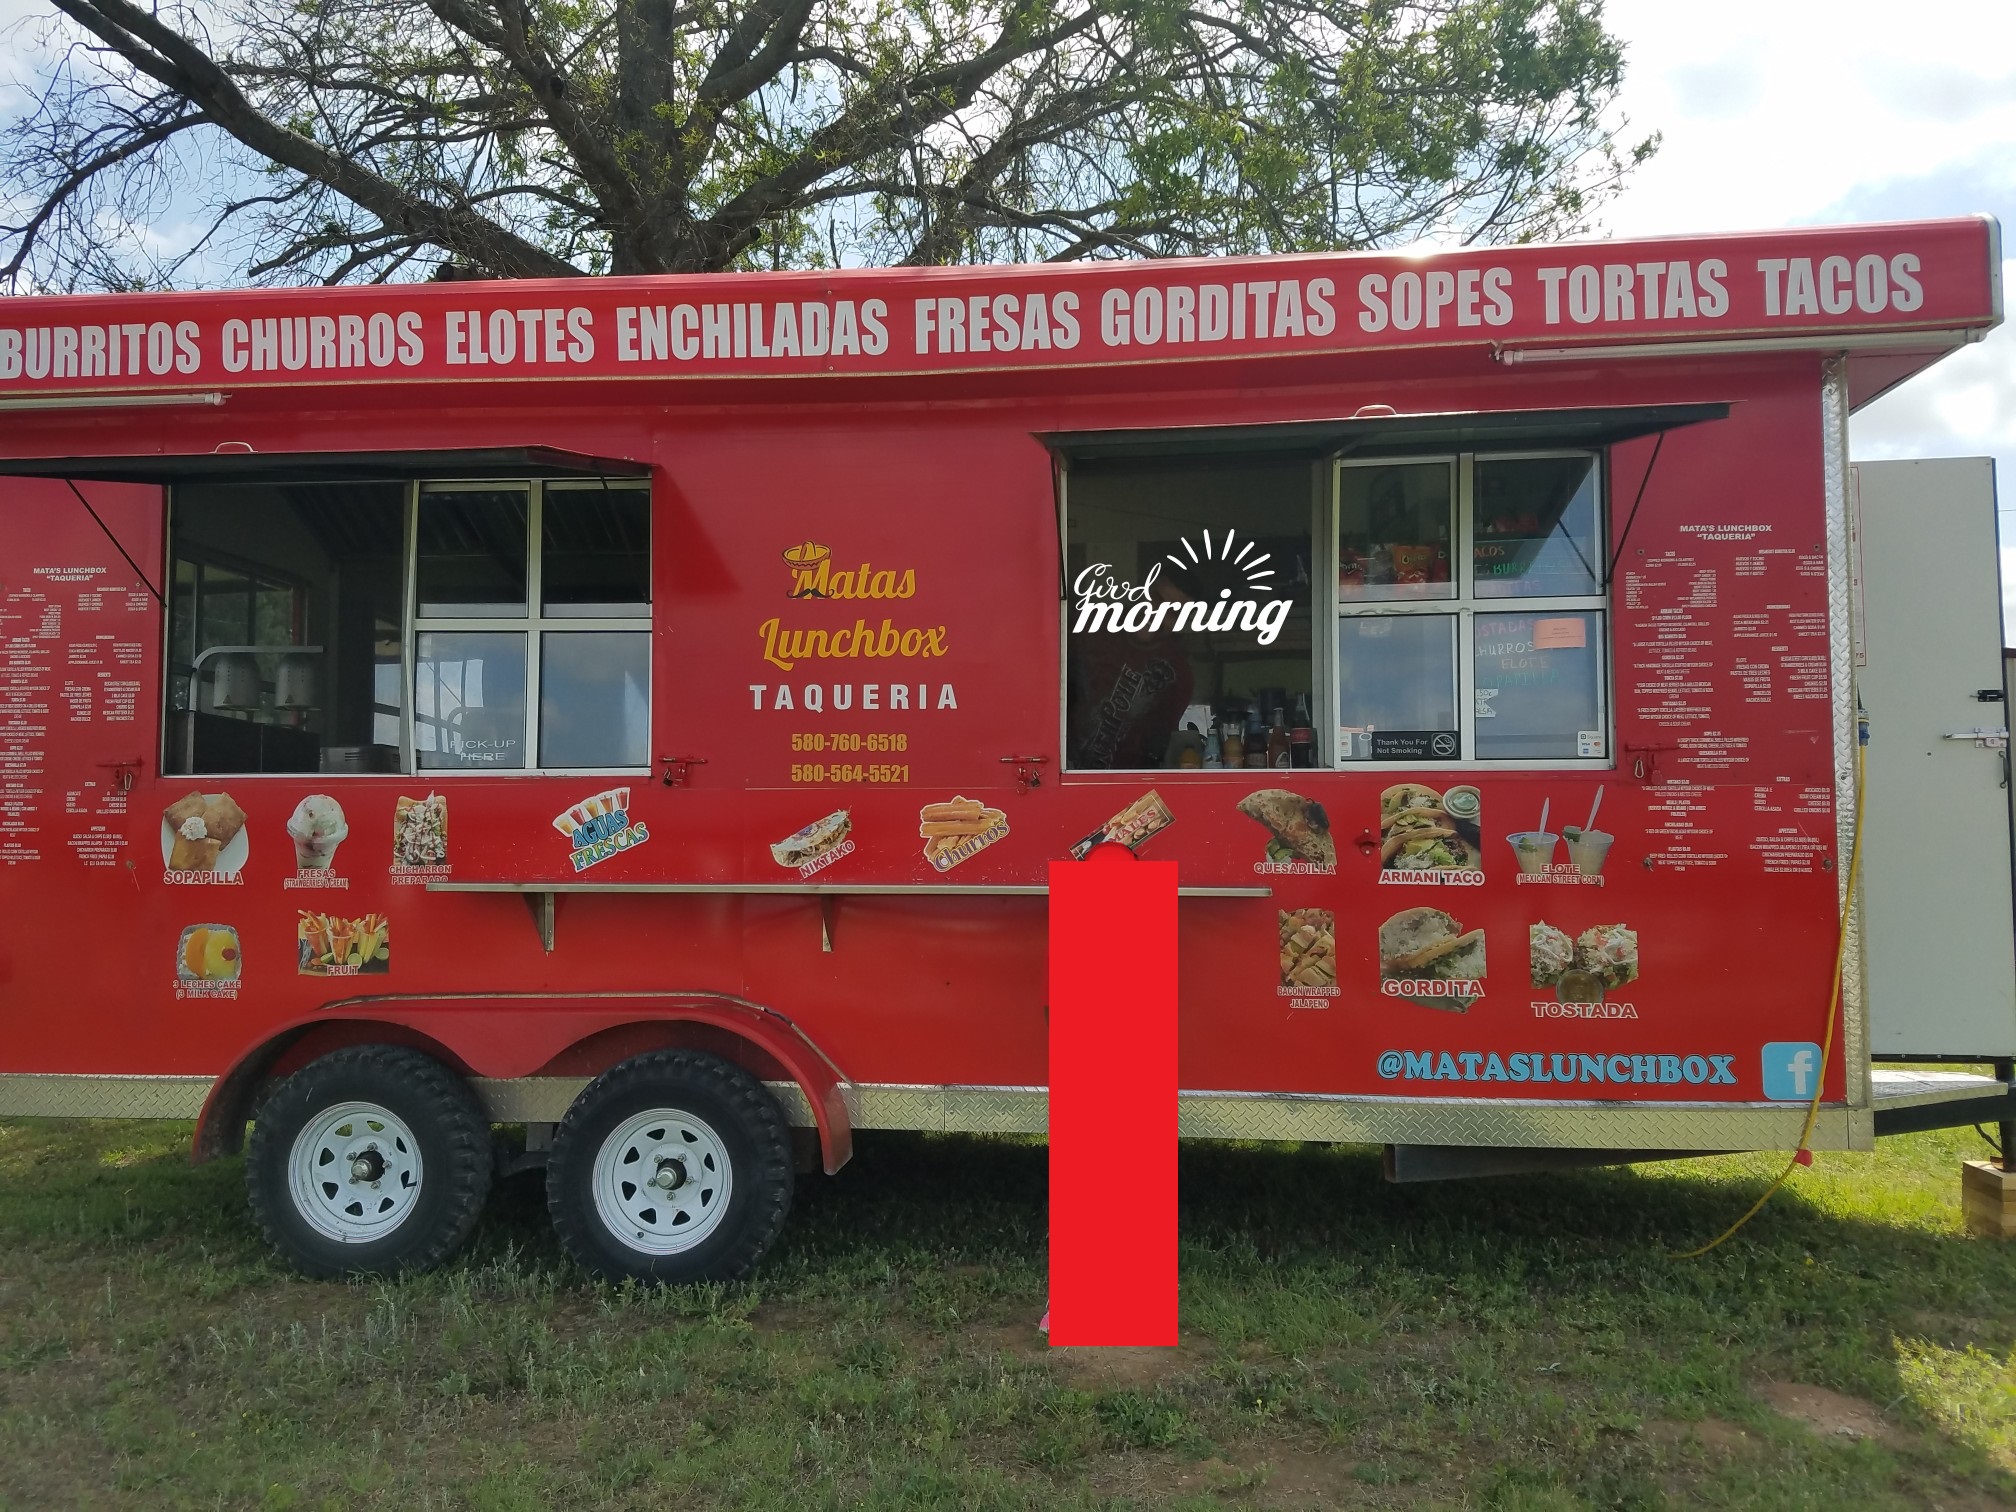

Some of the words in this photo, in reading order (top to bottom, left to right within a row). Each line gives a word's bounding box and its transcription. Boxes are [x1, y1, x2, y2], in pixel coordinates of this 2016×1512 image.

[0, 321, 200, 379] BURRITOS
[222, 312, 424, 373] CHURROS
[446, 307, 594, 366] ELOTES
[617, 298, 888, 361] ENCHILADAS
[915, 291, 1080, 355] FRESAS
[1101, 277, 1336, 347] GORDITAS
[1358, 266, 1514, 332] SOPES
[1538, 260, 1729, 325] TORTAS
[1757, 253, 1923, 318] TACOS
[1717, 524, 1772, 532] LUNCHBOX
[786, 558, 916, 600] Matas
[758, 617, 949, 671] Lunchbox
[750, 684, 958, 713] TAQUERIA
[791, 733, 907, 752] 580-760-6518
[460, 752, 506, 761] HERE
[1391, 747, 1422, 755] Smoking
[791, 764, 909, 783] 580-564-5521
[573, 809, 628, 848] AGUAS
[570, 822, 649, 871] FRESCAS
[933, 820, 1010, 872] Churros
[800, 840, 855, 878] NIKTAKO
[297, 869, 336, 879] FRESAS
[389, 865, 452, 875] CHICHARRON
[1254, 862, 1336, 875] QUESADILLA
[1541, 864, 1580, 874] ELOTE
[164, 870, 244, 886] SOPAPILLA
[1379, 869, 1441, 886] ARMANI
[1442, 869, 1485, 886] TACO
[1552, 874, 1581, 886] STREET
[327, 966, 359, 976] FRUIT
[172, 980, 179, 988] 3
[180, 980, 215, 988] LECHES
[217, 980, 241, 989] CAKE
[1277, 986, 1303, 996] BACON
[1304, 986, 1341, 997] WRAPPED
[1383, 979, 1485, 998] GORDITA
[175, 990, 184, 1000] (3
[186, 990, 209, 999] MILK
[210, 990, 238, 1000] CAKE)
[1290, 999, 1329, 1009] JALAPENO
[1532, 1002, 1638, 1019] TOSTADA
[1376, 1049, 1738, 1085] @MATASLUNCHBOX
